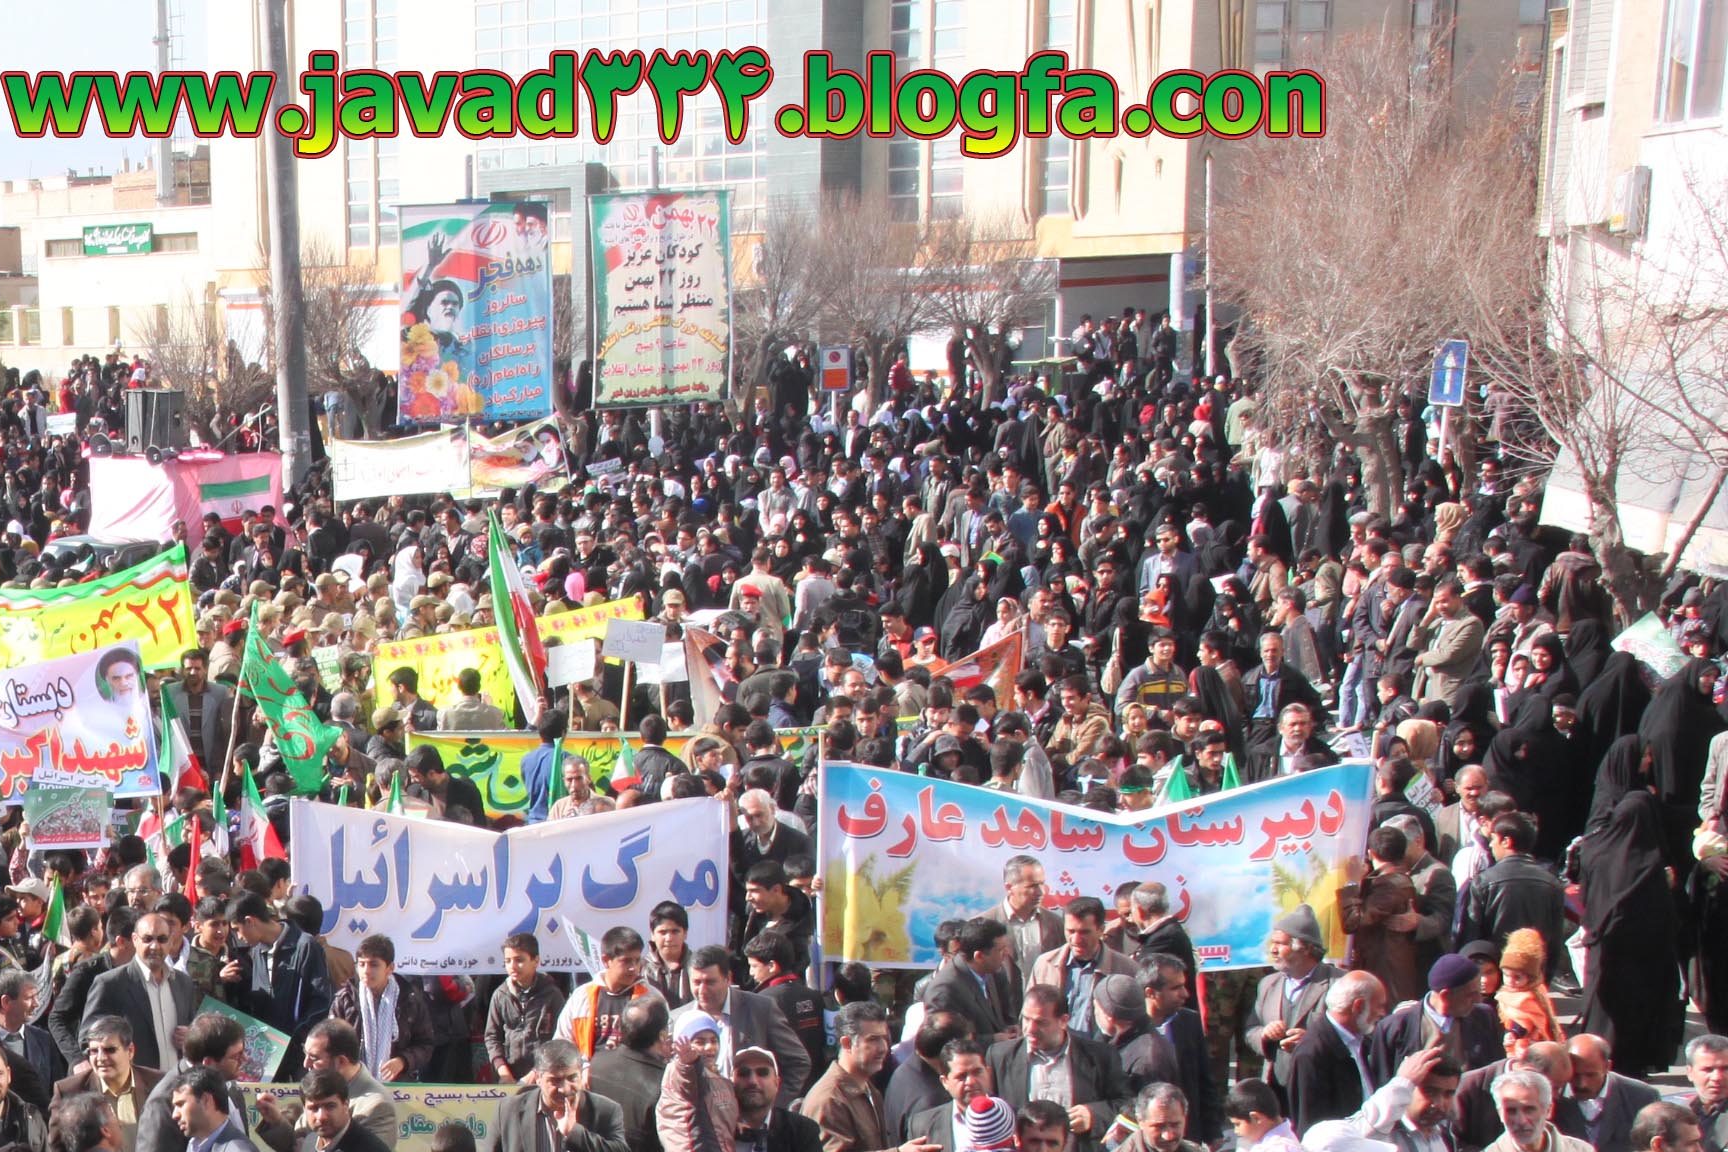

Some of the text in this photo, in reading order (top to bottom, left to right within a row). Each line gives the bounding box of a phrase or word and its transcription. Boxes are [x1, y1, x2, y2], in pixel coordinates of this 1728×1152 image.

[623, 243, 703, 267] کودکان عزیز
[467, 251, 542, 300] دهه فجر
[625, 275, 654, 292] بهمن
[679, 273, 701, 289] روز
[484, 294, 528, 316] سالروز
[677, 293, 714, 314] منتظر
[126, 590, 183, 647] ۲۲
[836, 779, 967, 860] عارف
[1121, 785, 1347, 868] دبیرستان
[581, 825, 721, 912] مرگ
